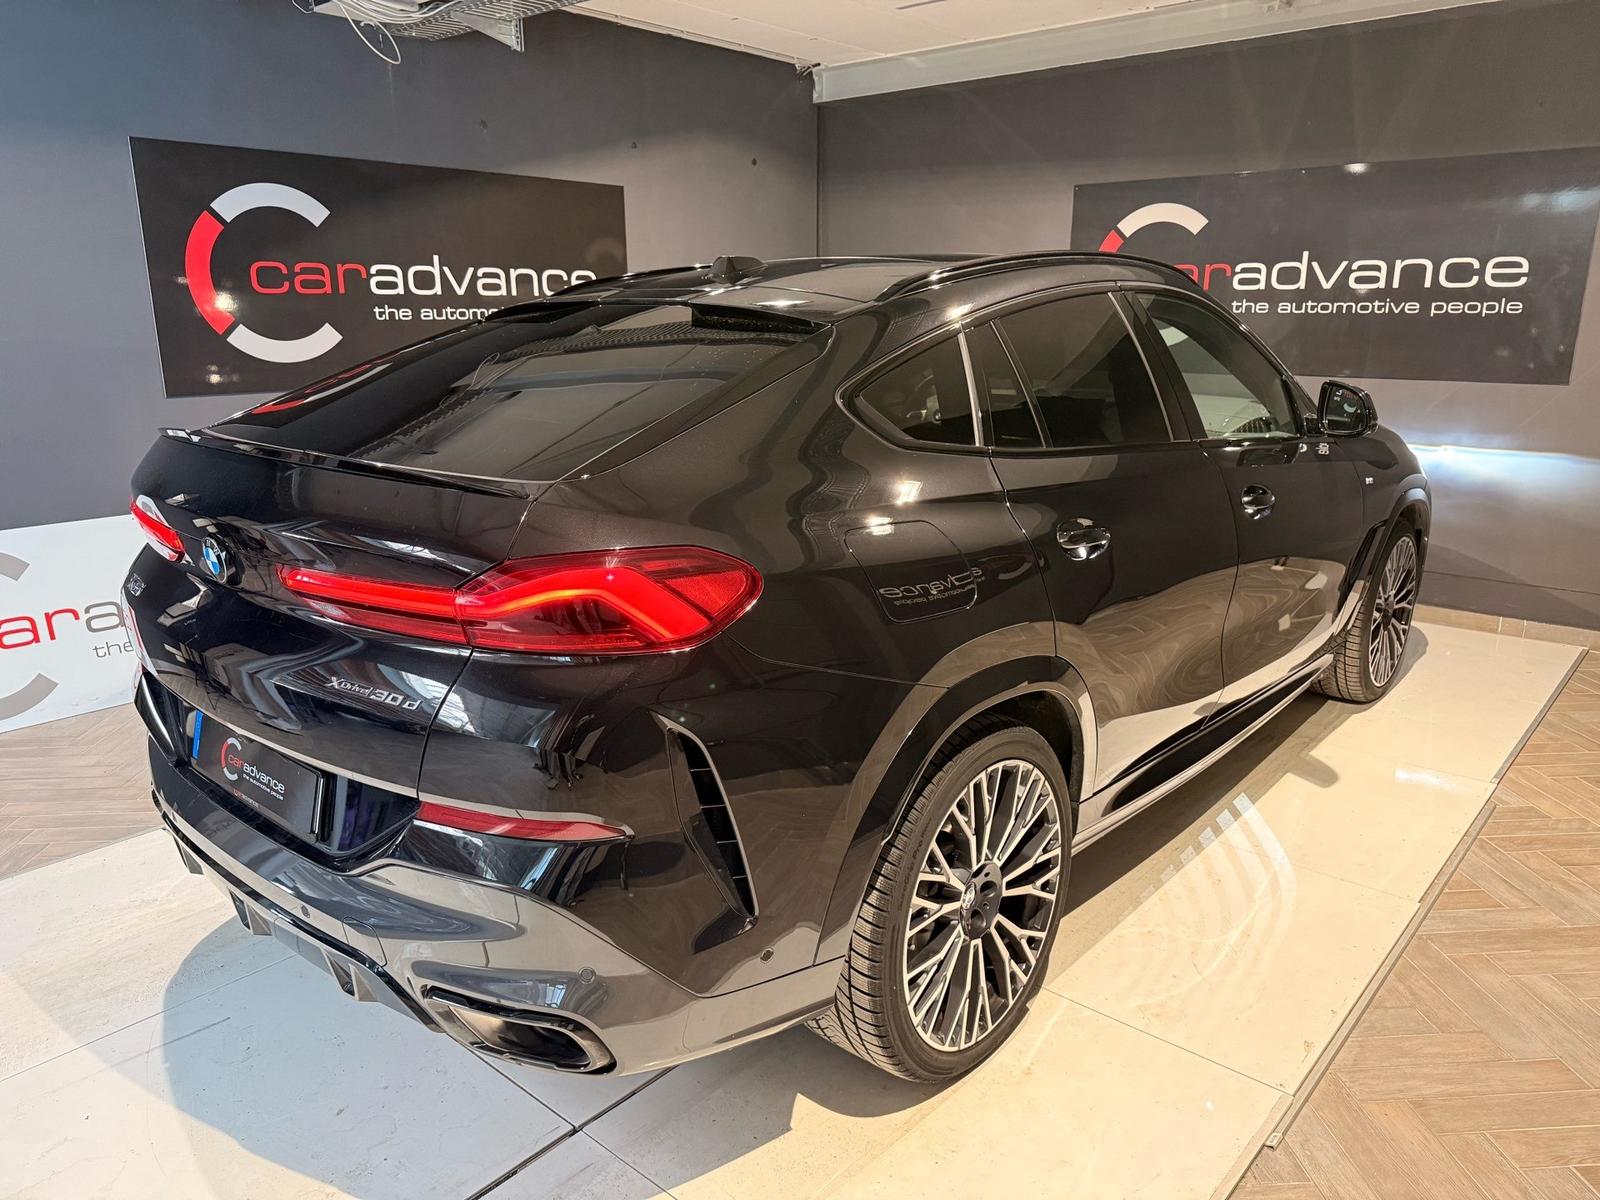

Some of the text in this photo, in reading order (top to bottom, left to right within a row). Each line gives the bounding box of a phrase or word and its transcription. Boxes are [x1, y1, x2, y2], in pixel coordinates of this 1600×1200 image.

[1173, 250, 1530, 292] radvance
[373, 305, 500, 321] the autom
[1231, 298, 1524, 318] the automotive people
[0, 600, 124, 650] ara
[92, 640, 134, 658] the
[227, 754, 286, 794] caradvance
